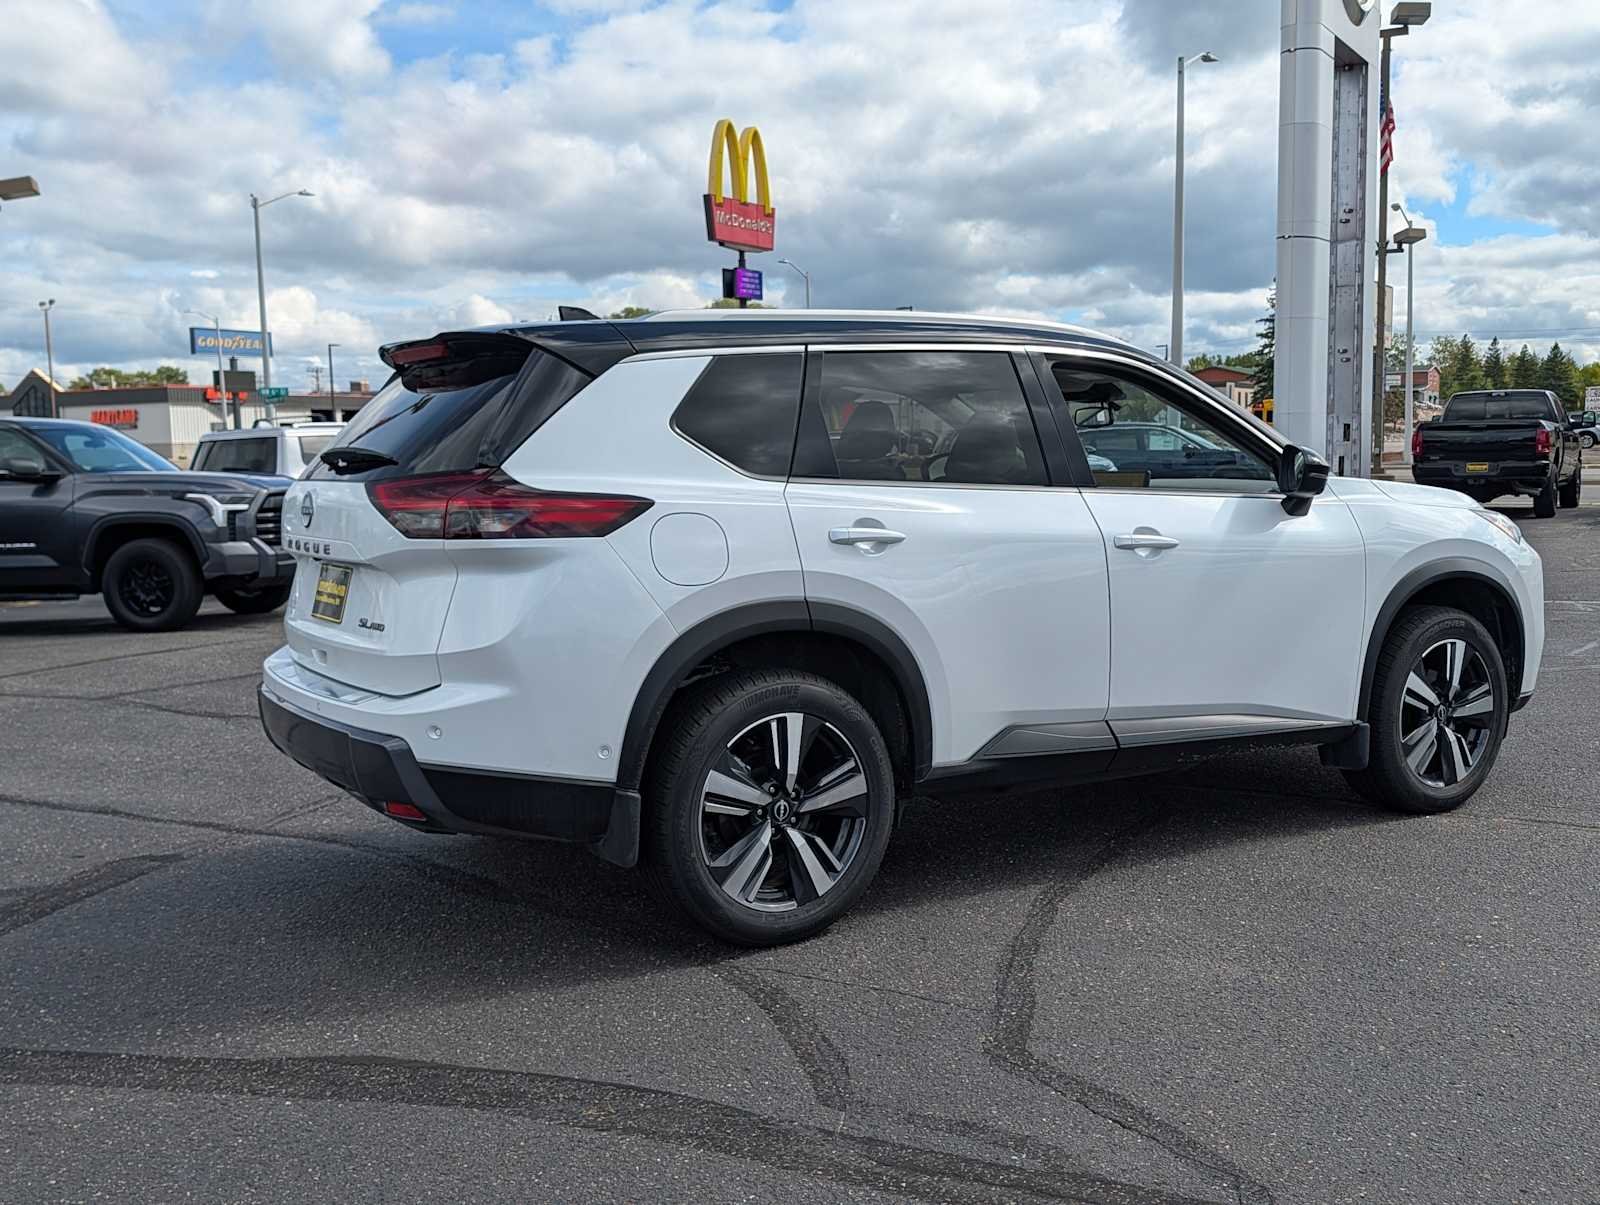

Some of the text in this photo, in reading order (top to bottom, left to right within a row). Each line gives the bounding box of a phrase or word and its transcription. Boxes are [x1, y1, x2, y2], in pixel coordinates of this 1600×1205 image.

[716, 209, 773, 234] McDonald's
[287, 538, 331, 555] ROGUE
[358, 617, 372, 630] SL
